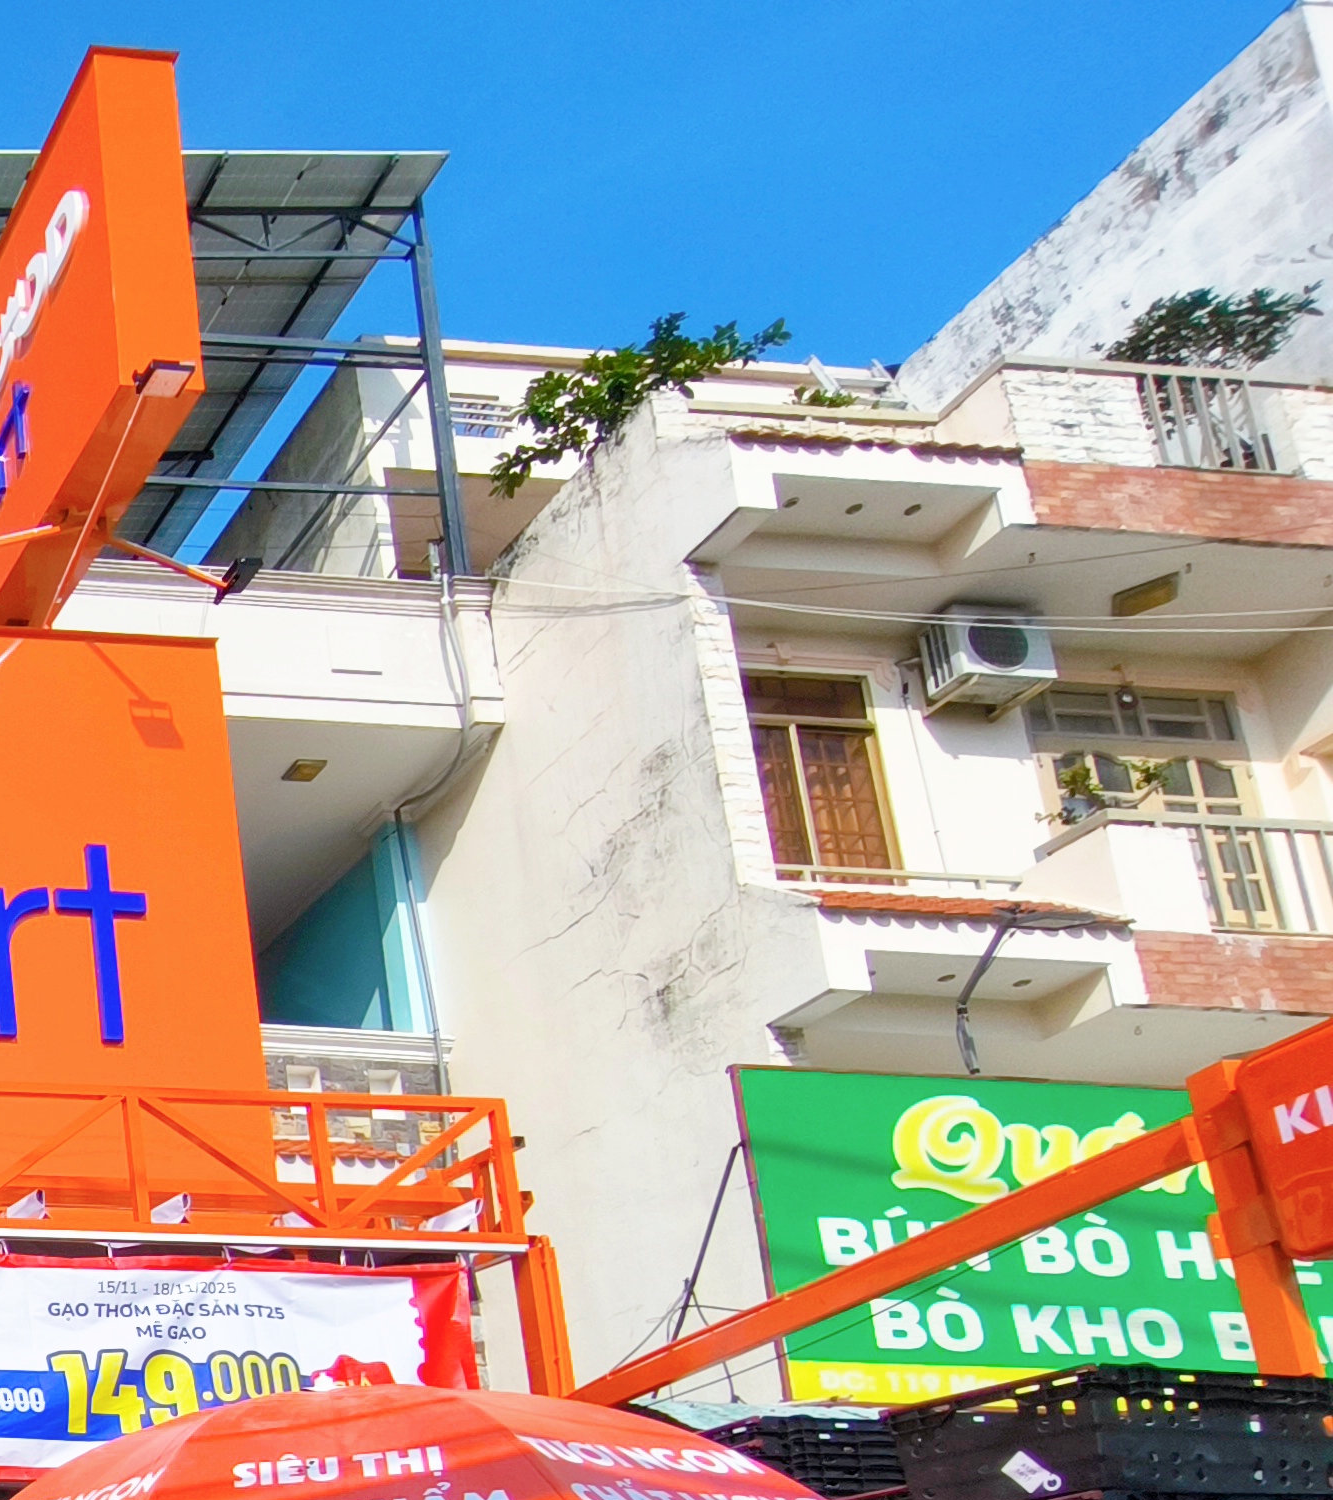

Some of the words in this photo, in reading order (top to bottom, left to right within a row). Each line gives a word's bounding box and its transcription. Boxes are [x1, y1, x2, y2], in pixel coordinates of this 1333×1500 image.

[1019, 1212, 1131, 1277] BÒ
[98, 1281, 138, 1295] 15/11
[48, 1302, 88, 1321] GẠO
[94, 1300, 151, 1318] THƠM
[156, 1299, 195, 1320] ĐẶC
[199, 1298, 240, 1317] SẢN
[244, 1304, 285, 1320] ST25
[869, 1286, 985, 1353] BÒ
[1010, 1303, 1184, 1359] KHO
[168, 1325, 206, 1345] GẠO
[233, 1453, 339, 1489] SIÊU
[353, 1446, 444, 1478] THỊ
[628, 1440, 765, 1476] NGON
